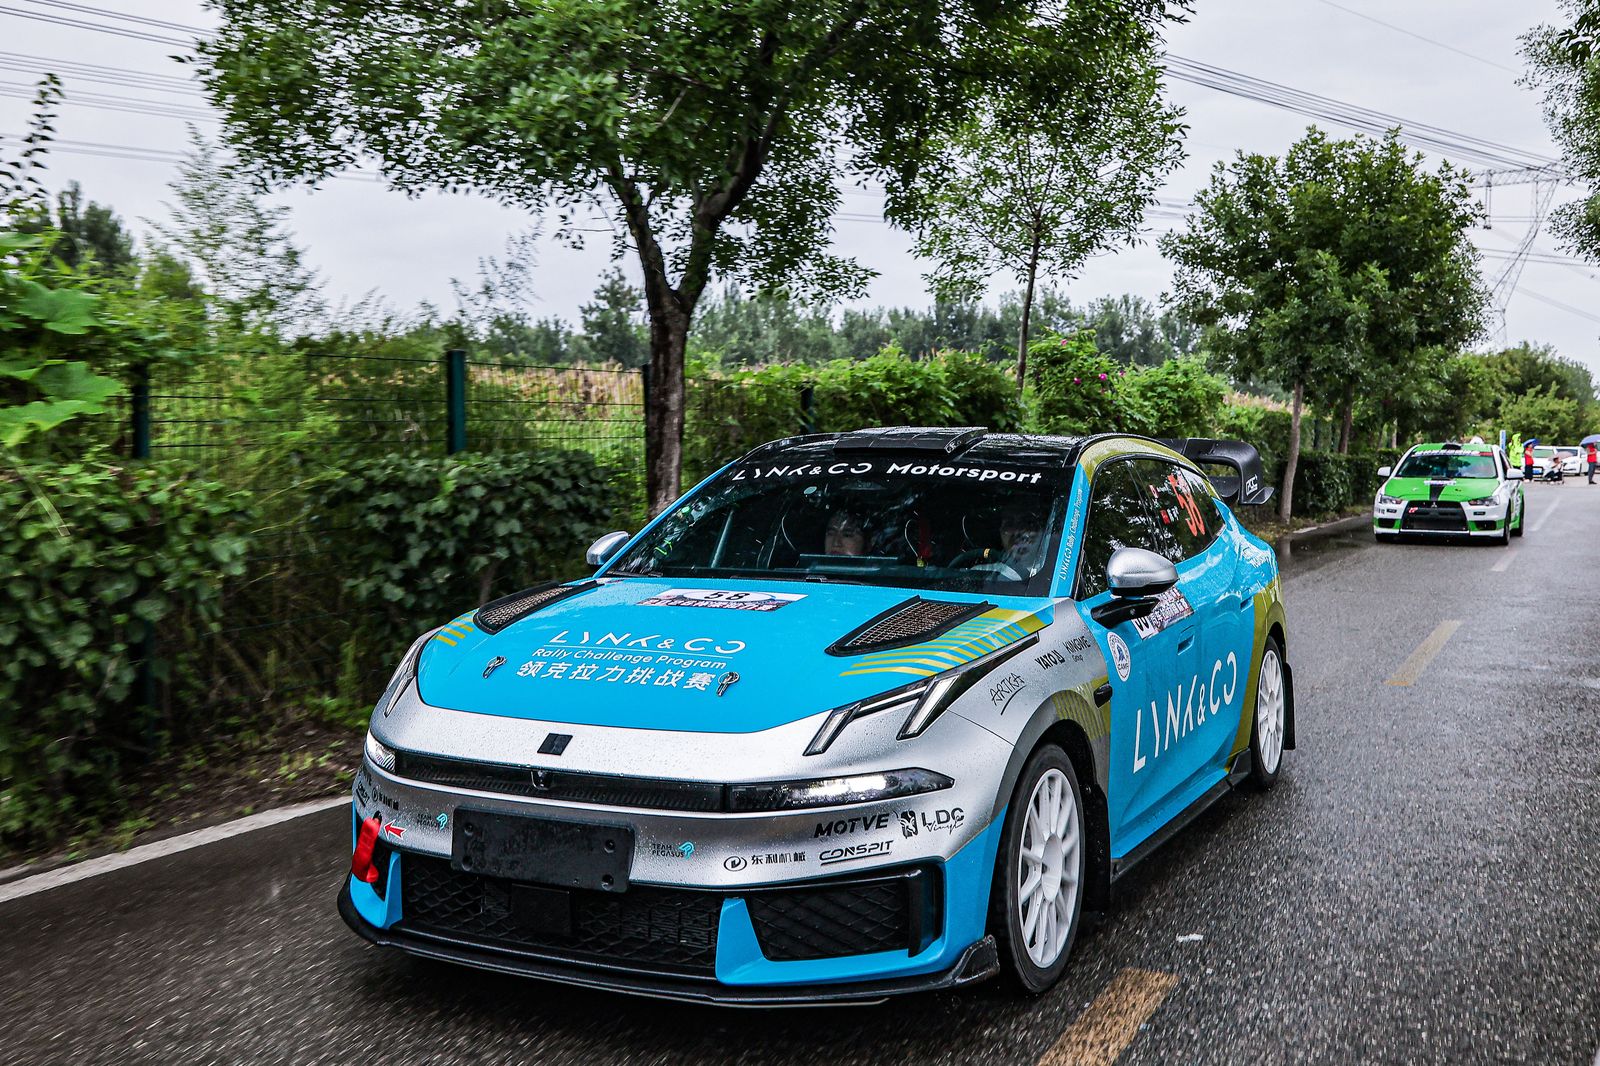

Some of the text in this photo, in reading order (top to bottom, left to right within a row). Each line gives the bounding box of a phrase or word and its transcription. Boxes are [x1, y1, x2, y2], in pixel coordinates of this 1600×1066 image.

[886, 462, 1042, 484] Motorsport
[703, 591, 751, 601] 58
[531, 647, 727, 670] Rally Challenge Program
[515, 660, 718, 692] 领克拉力挑战赛
[813, 813, 890, 839] MOTVE
[652, 850, 684, 858] PEGASUS
[819, 840, 894, 861] CONSPIT
